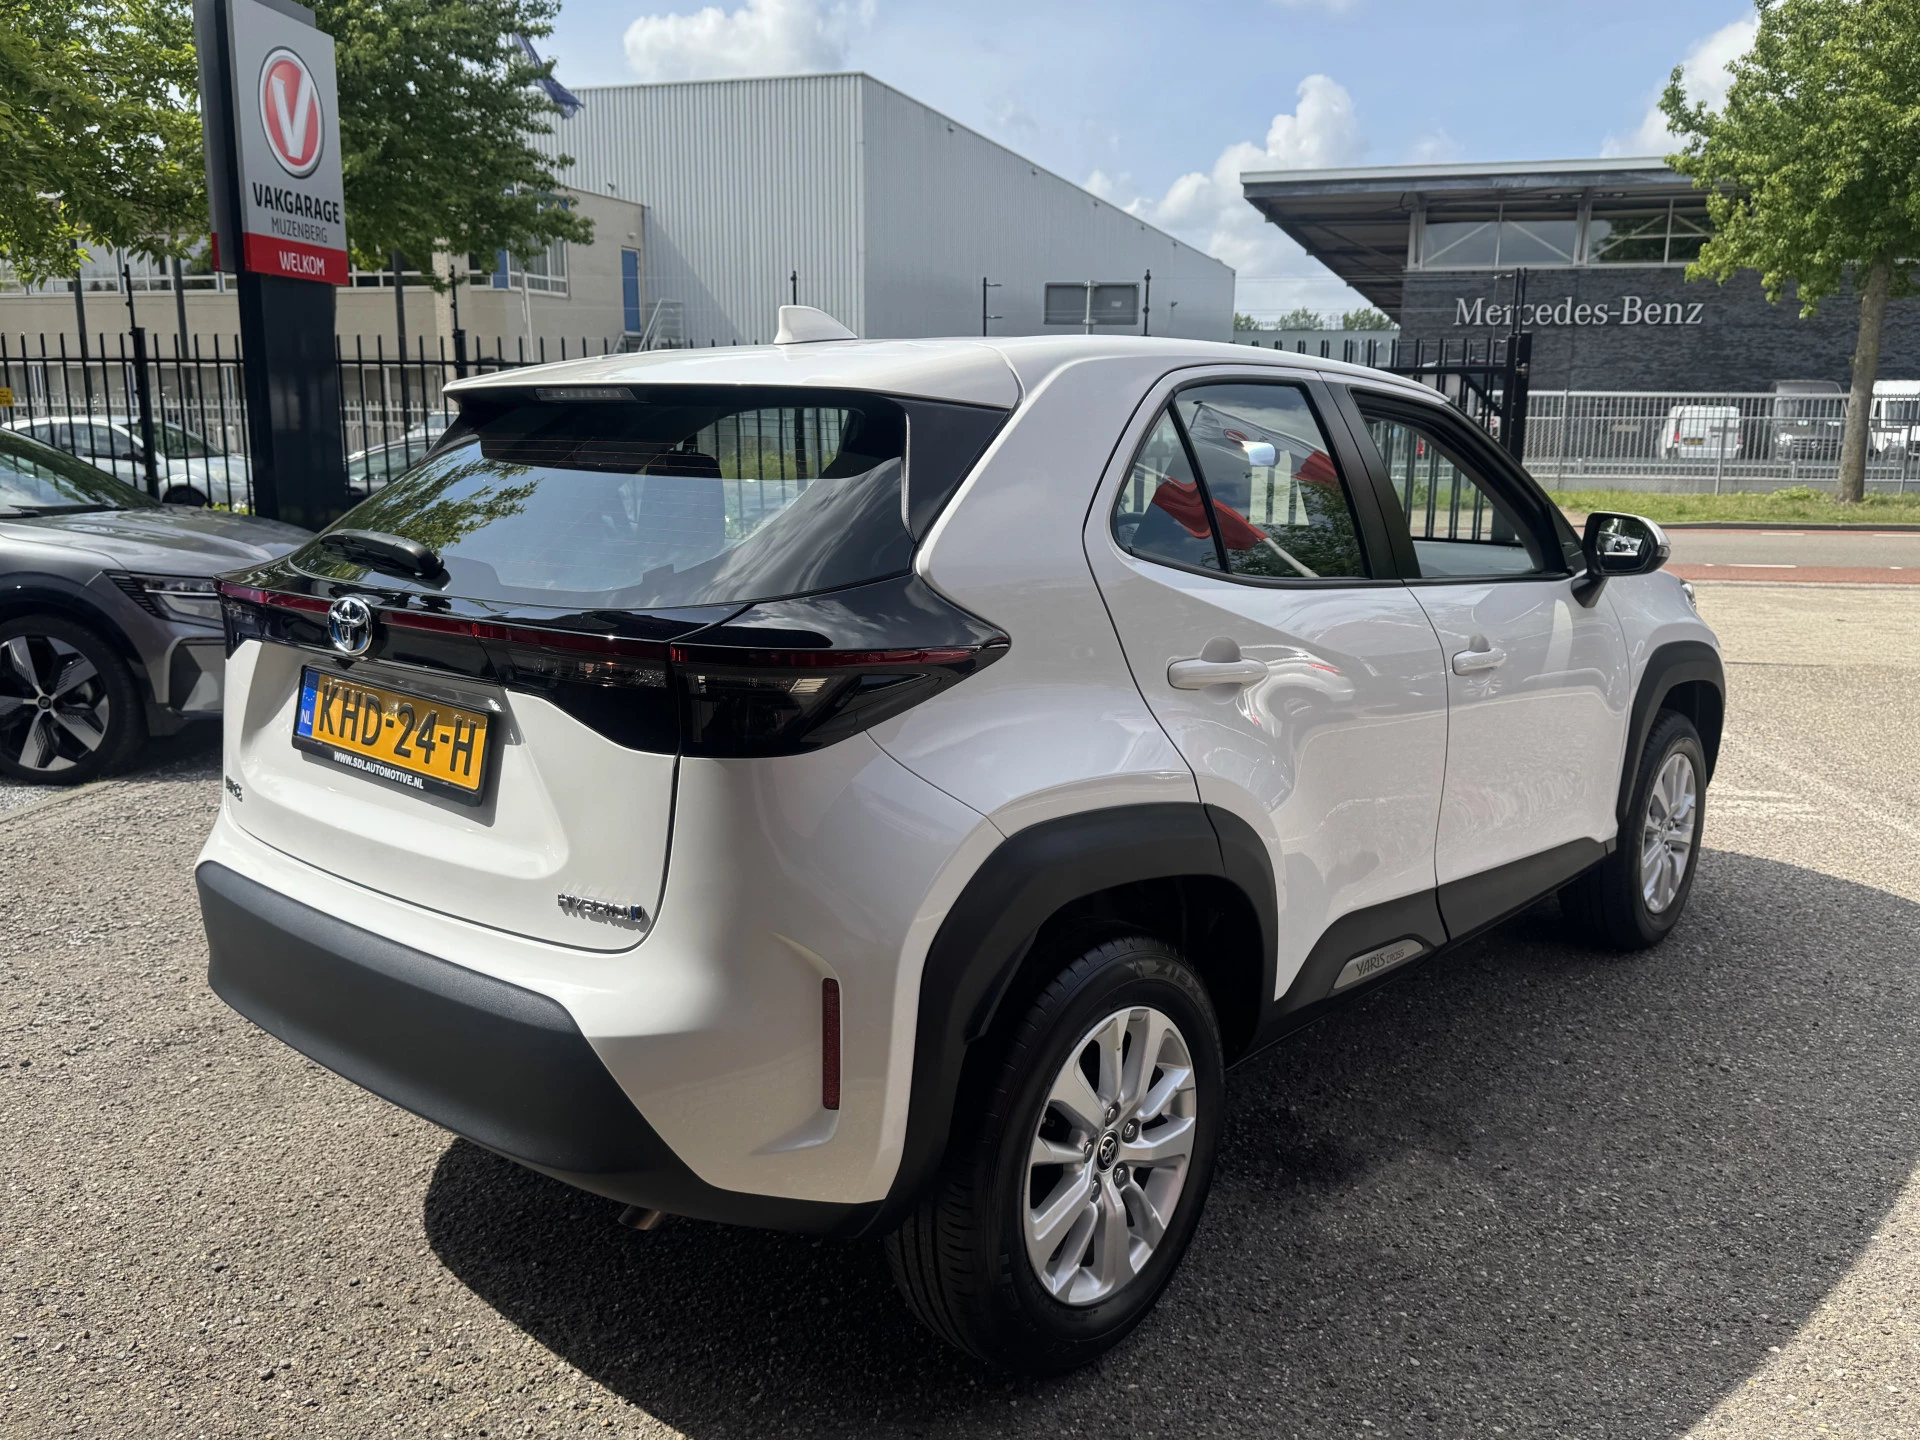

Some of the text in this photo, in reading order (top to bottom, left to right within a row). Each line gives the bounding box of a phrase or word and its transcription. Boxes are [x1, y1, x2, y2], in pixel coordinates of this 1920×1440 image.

[252, 182, 340, 225] VAKGARAGE
[271, 216, 328, 244] MUZENBERG
[278, 250, 326, 276] WELKOM
[1453, 296, 1704, 326] Mercedes-Benz
[300, 708, 312, 726] NL
[318, 681, 477, 777] KHD-24-H
[334, 751, 424, 790] WWW.SDLAUTOMOTIVE.NL
